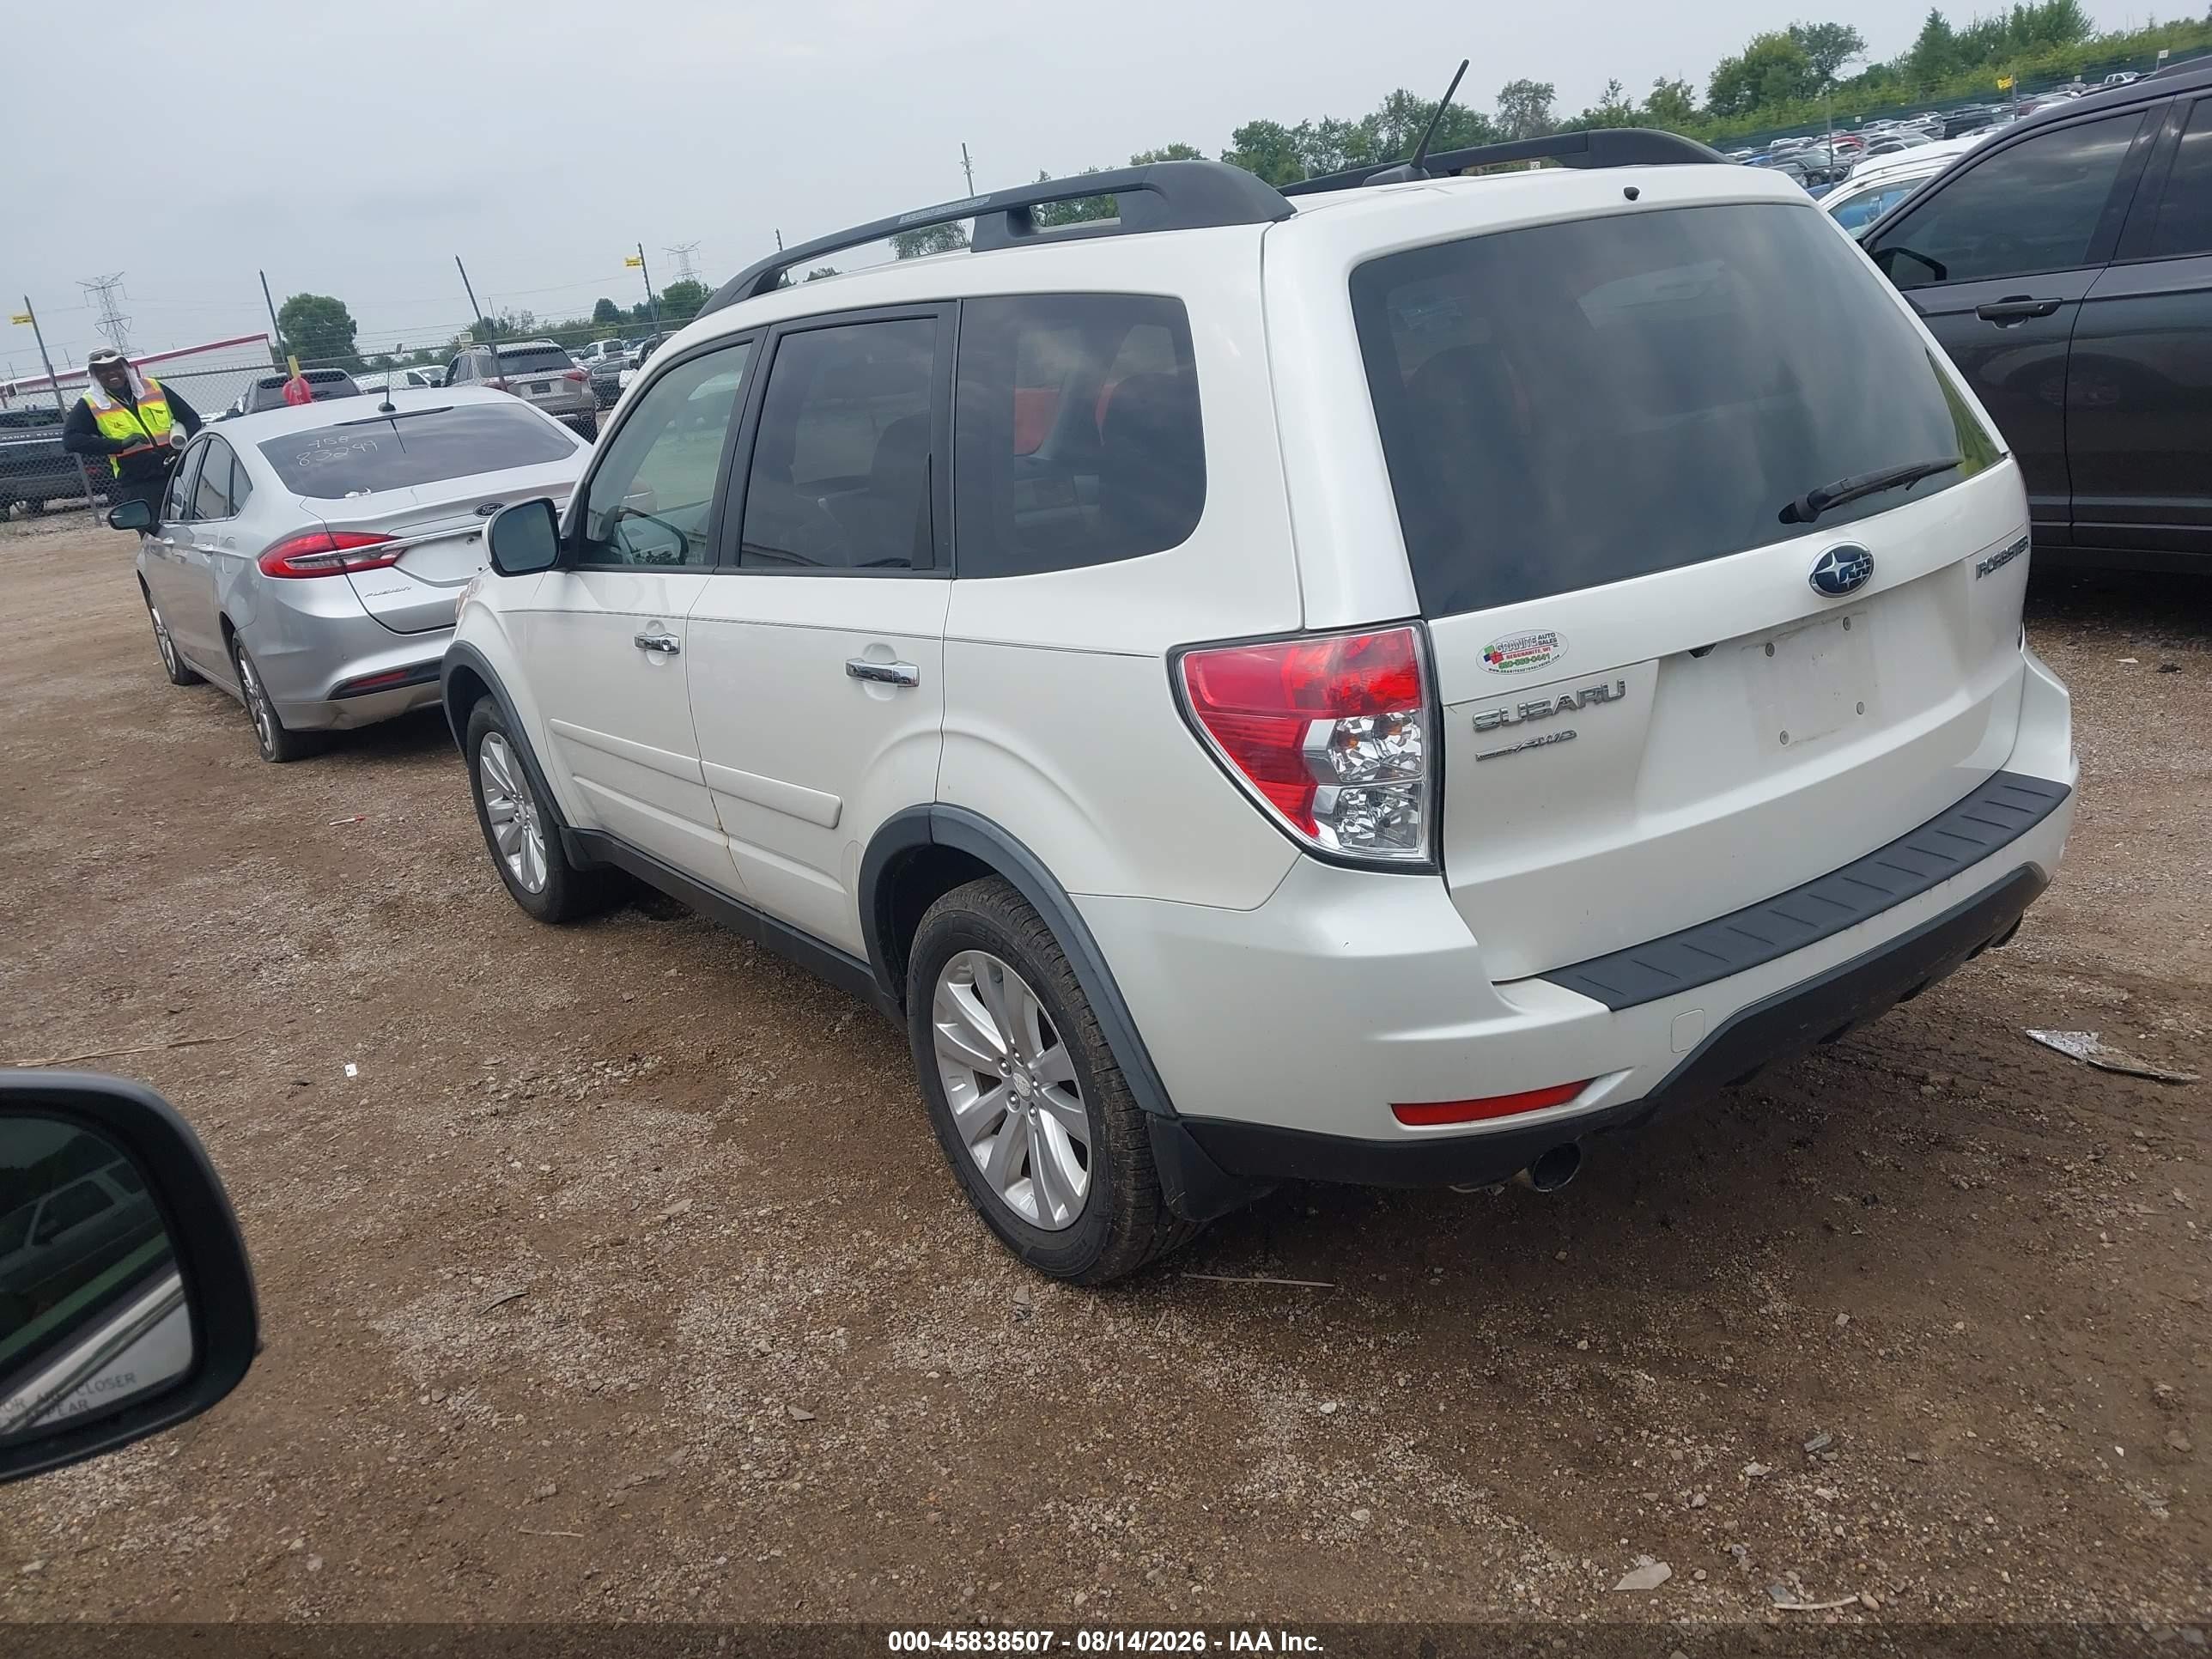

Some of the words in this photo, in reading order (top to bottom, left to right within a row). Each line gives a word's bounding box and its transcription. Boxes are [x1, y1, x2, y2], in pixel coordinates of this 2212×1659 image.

[1496, 635, 1538, 653] GRANITE
[1538, 632, 1557, 641] AUTO
[1473, 679, 1626, 732] SUBARU
[77, 1371, 138, 1397] CLOSER
